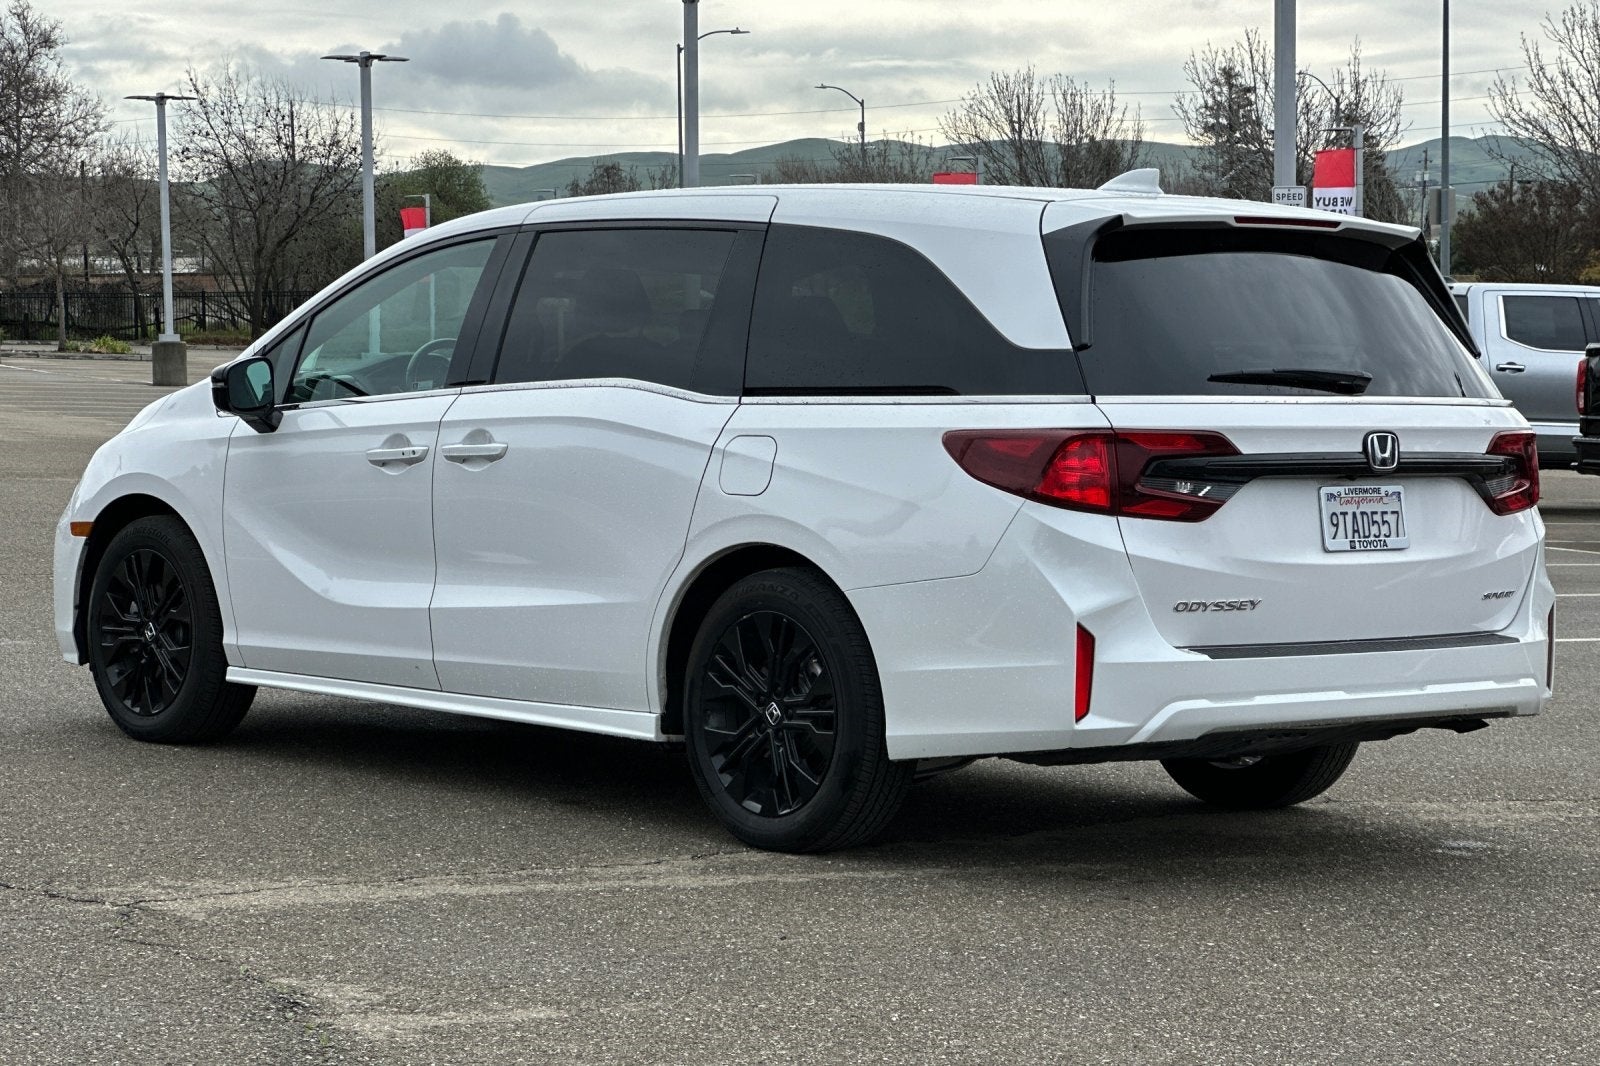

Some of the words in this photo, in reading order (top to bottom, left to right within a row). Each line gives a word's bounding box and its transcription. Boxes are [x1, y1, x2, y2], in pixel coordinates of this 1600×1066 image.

[1344, 487, 1382, 496] LIVERMORE
[1330, 510, 1400, 540] 9TAD557
[1356, 539, 1388, 549] TOYOTA
[1173, 599, 1262, 613] ODYSSEY
